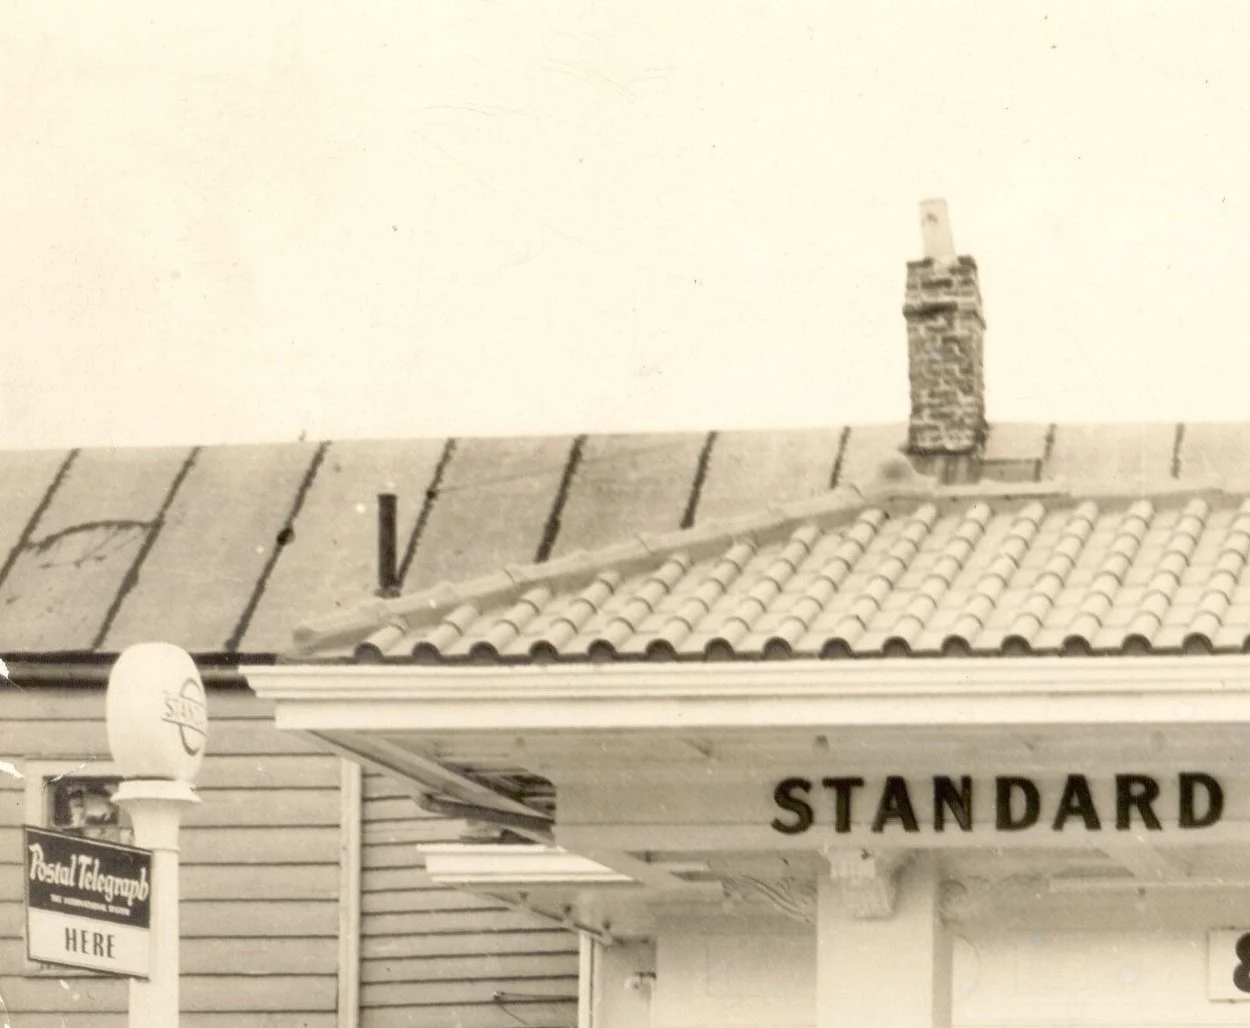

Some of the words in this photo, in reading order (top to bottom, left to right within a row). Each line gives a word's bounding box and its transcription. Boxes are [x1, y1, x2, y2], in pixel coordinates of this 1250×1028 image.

[771, 771, 1225, 834] STANDARD
[29, 843, 76, 887] Postal
[78, 853, 149, 906] Telegraph
[65, 927, 116, 959] HERE
